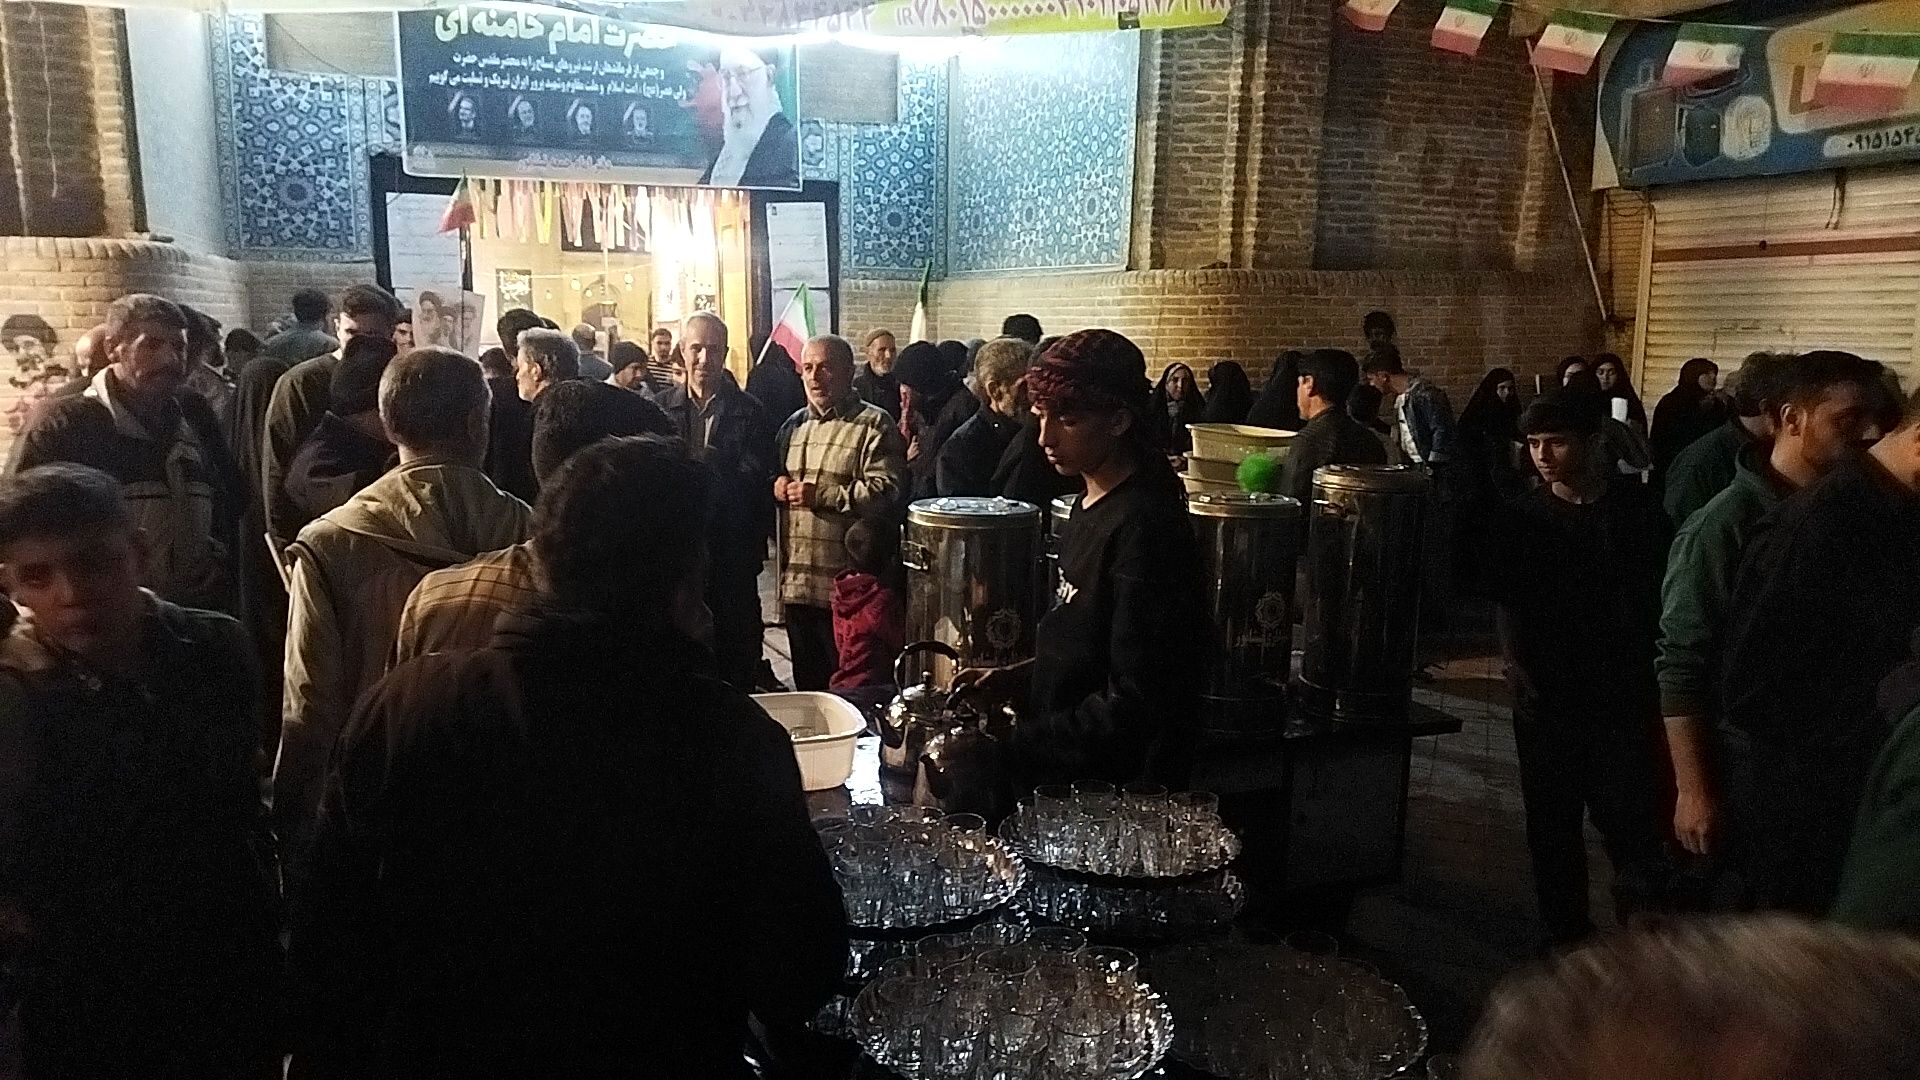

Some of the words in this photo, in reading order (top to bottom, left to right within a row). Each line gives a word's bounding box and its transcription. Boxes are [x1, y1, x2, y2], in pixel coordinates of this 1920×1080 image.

[434, 4, 469, 42] ای
[471, 9, 545, 39] خامنه
[548, 14, 600, 55] امام
[452, 51, 477, 67] حضرت
